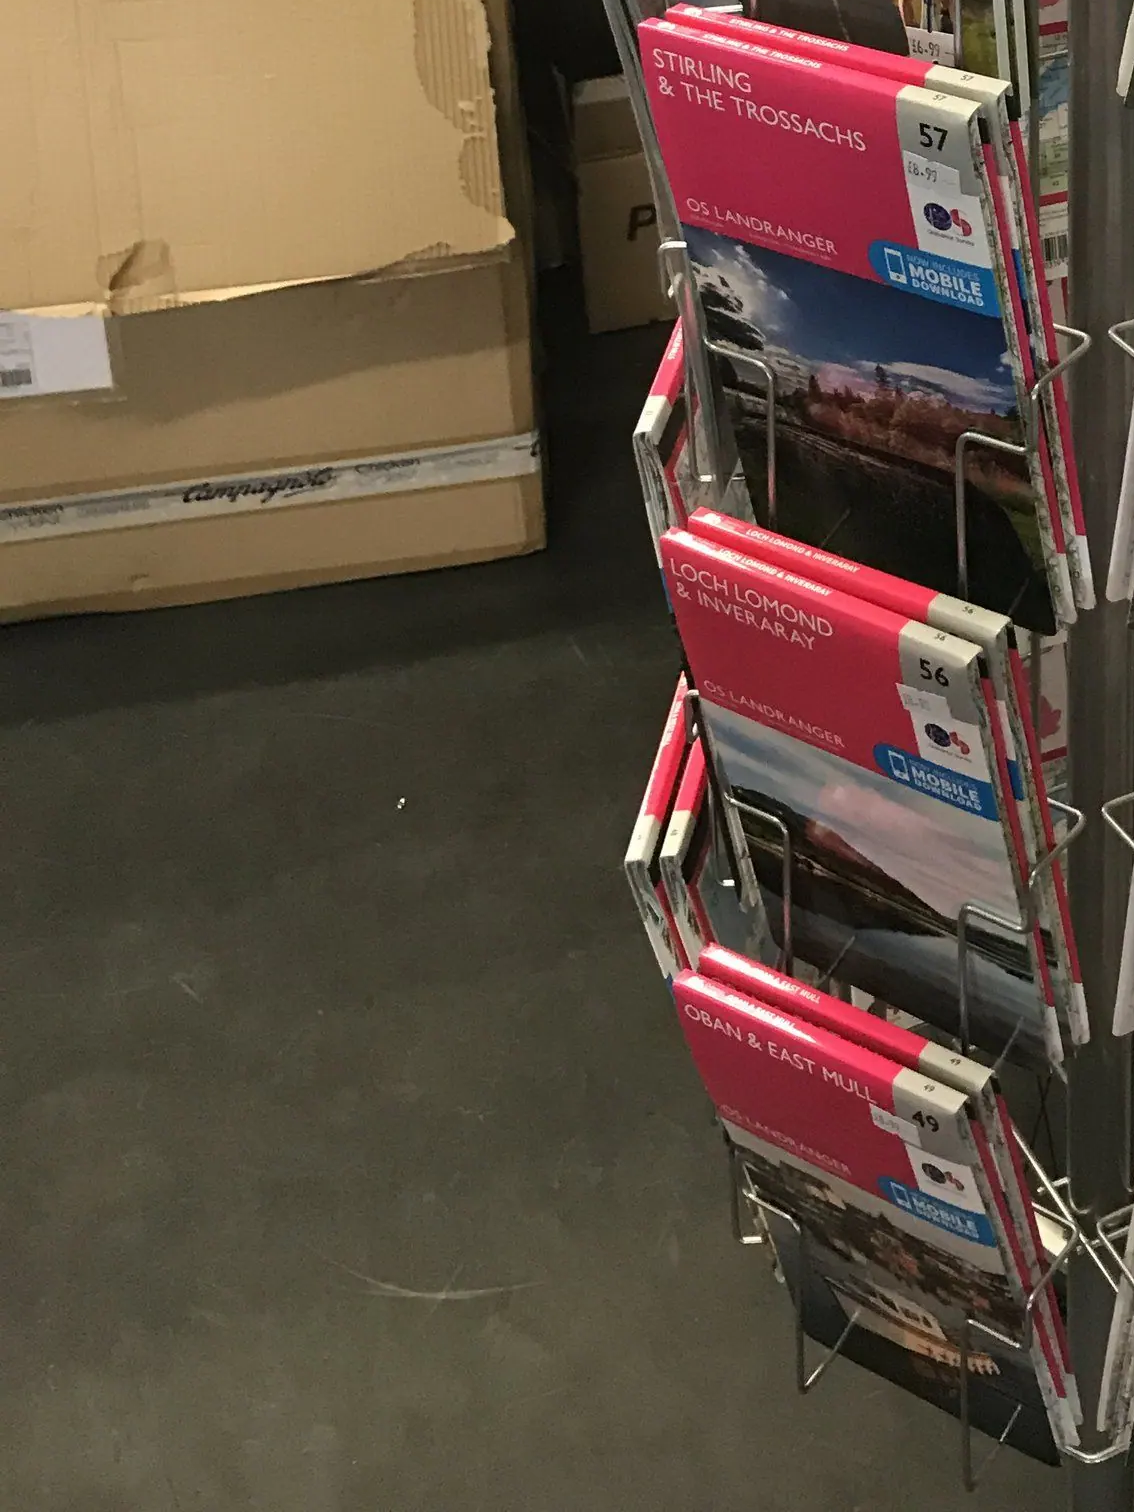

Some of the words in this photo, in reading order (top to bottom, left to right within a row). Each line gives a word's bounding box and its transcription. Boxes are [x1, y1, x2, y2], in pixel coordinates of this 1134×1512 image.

[652, 47, 752, 94] STIRLING
[658, 76, 675, 97] &
[684, 83, 726, 112] THE
[730, 95, 867, 153] TROSSACHS
[919, 121, 949, 152] 57
[686, 197, 710, 216] OS
[714, 206, 838, 256] LANDRANGER
[909, 263, 984, 298] MOBILE
[911, 277, 985, 308] DOWNLOAD
[745, 528, 769, 541] LOCH
[769, 537, 806, 556] LOMOND
[670, 557, 730, 597] LOCH
[734, 583, 834, 638] LOMOND
[676, 583, 693, 603] &
[697, 592, 816, 653] INVERARAY
[919, 657, 949, 687] 56
[703, 679, 726, 697] OS
[729, 691, 845, 749] LANDRANGER
[911, 766, 981, 803] MOBILE
[683, 1003, 743, 1045] OBAN
[747, 1031, 763, 1052] &
[768, 1040, 816, 1076] EAST
[821, 1066, 878, 1105] MULL
[912, 1110, 940, 1133] 49
